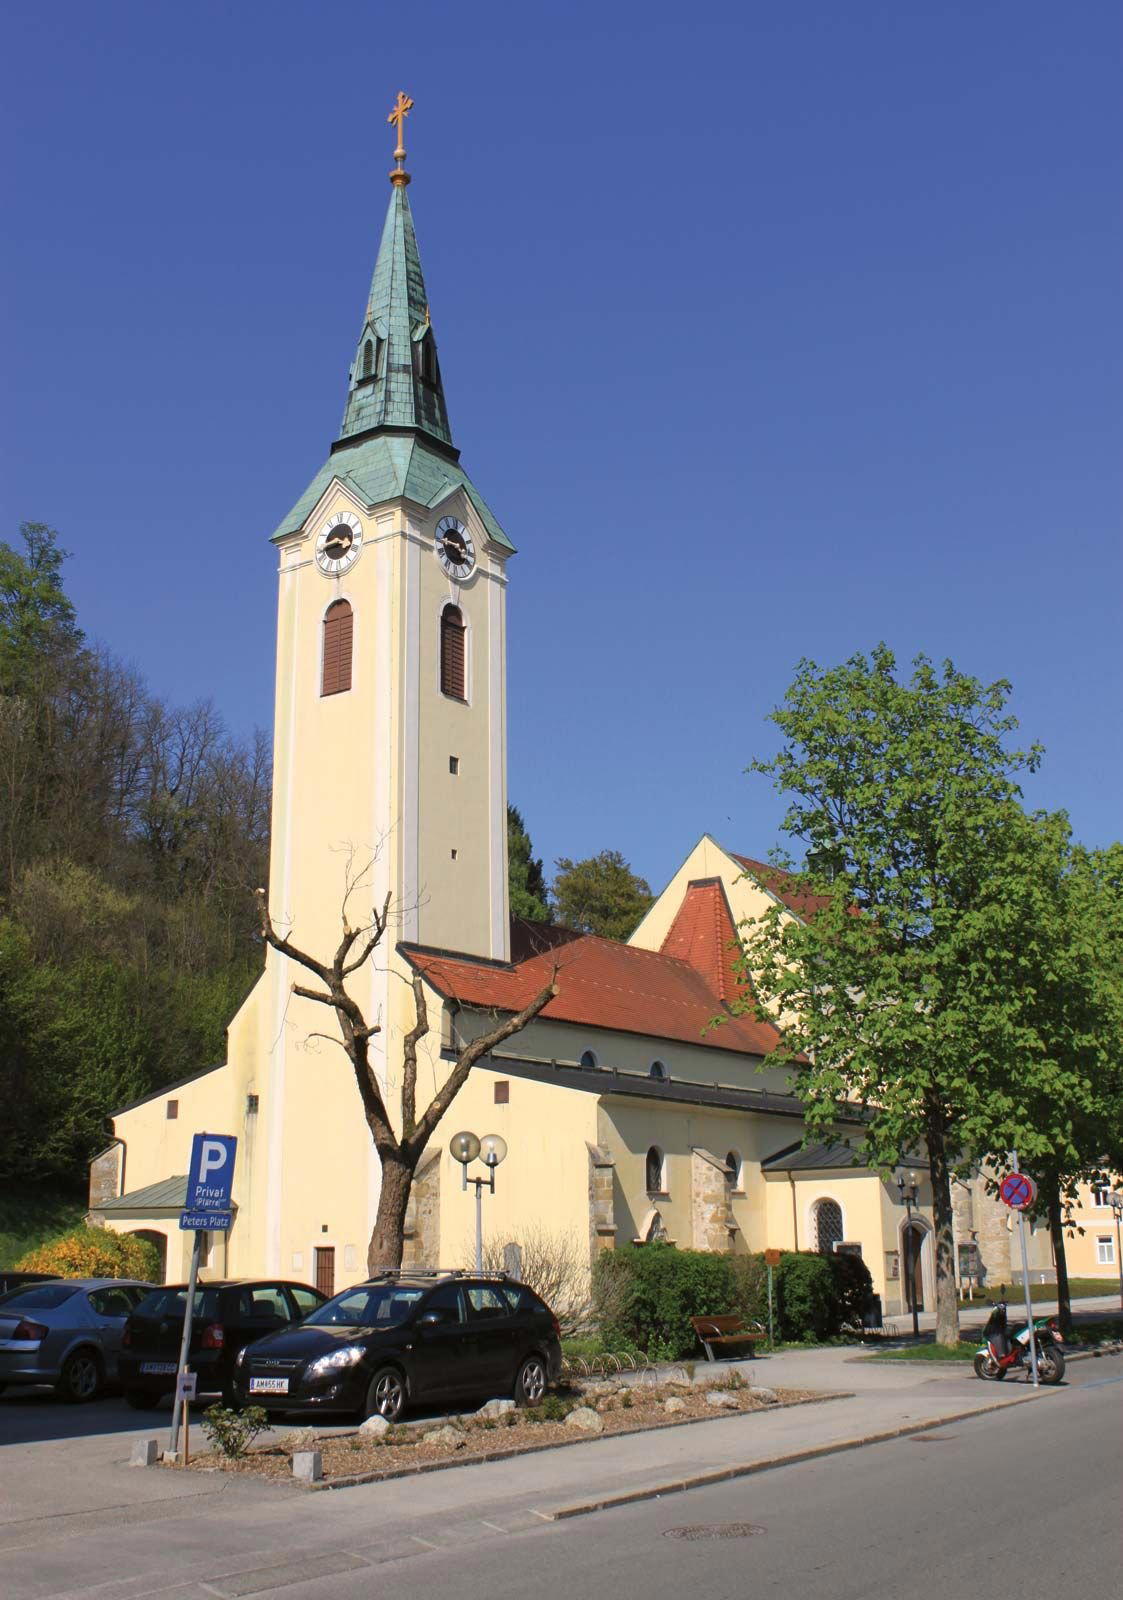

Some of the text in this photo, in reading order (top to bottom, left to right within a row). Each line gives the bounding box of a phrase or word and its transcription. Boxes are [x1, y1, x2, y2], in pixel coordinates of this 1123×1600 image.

[198, 1140, 228, 1183] P
[195, 1185, 225, 1198] Privat
[182, 1215, 229, 1227] Peters Platz
